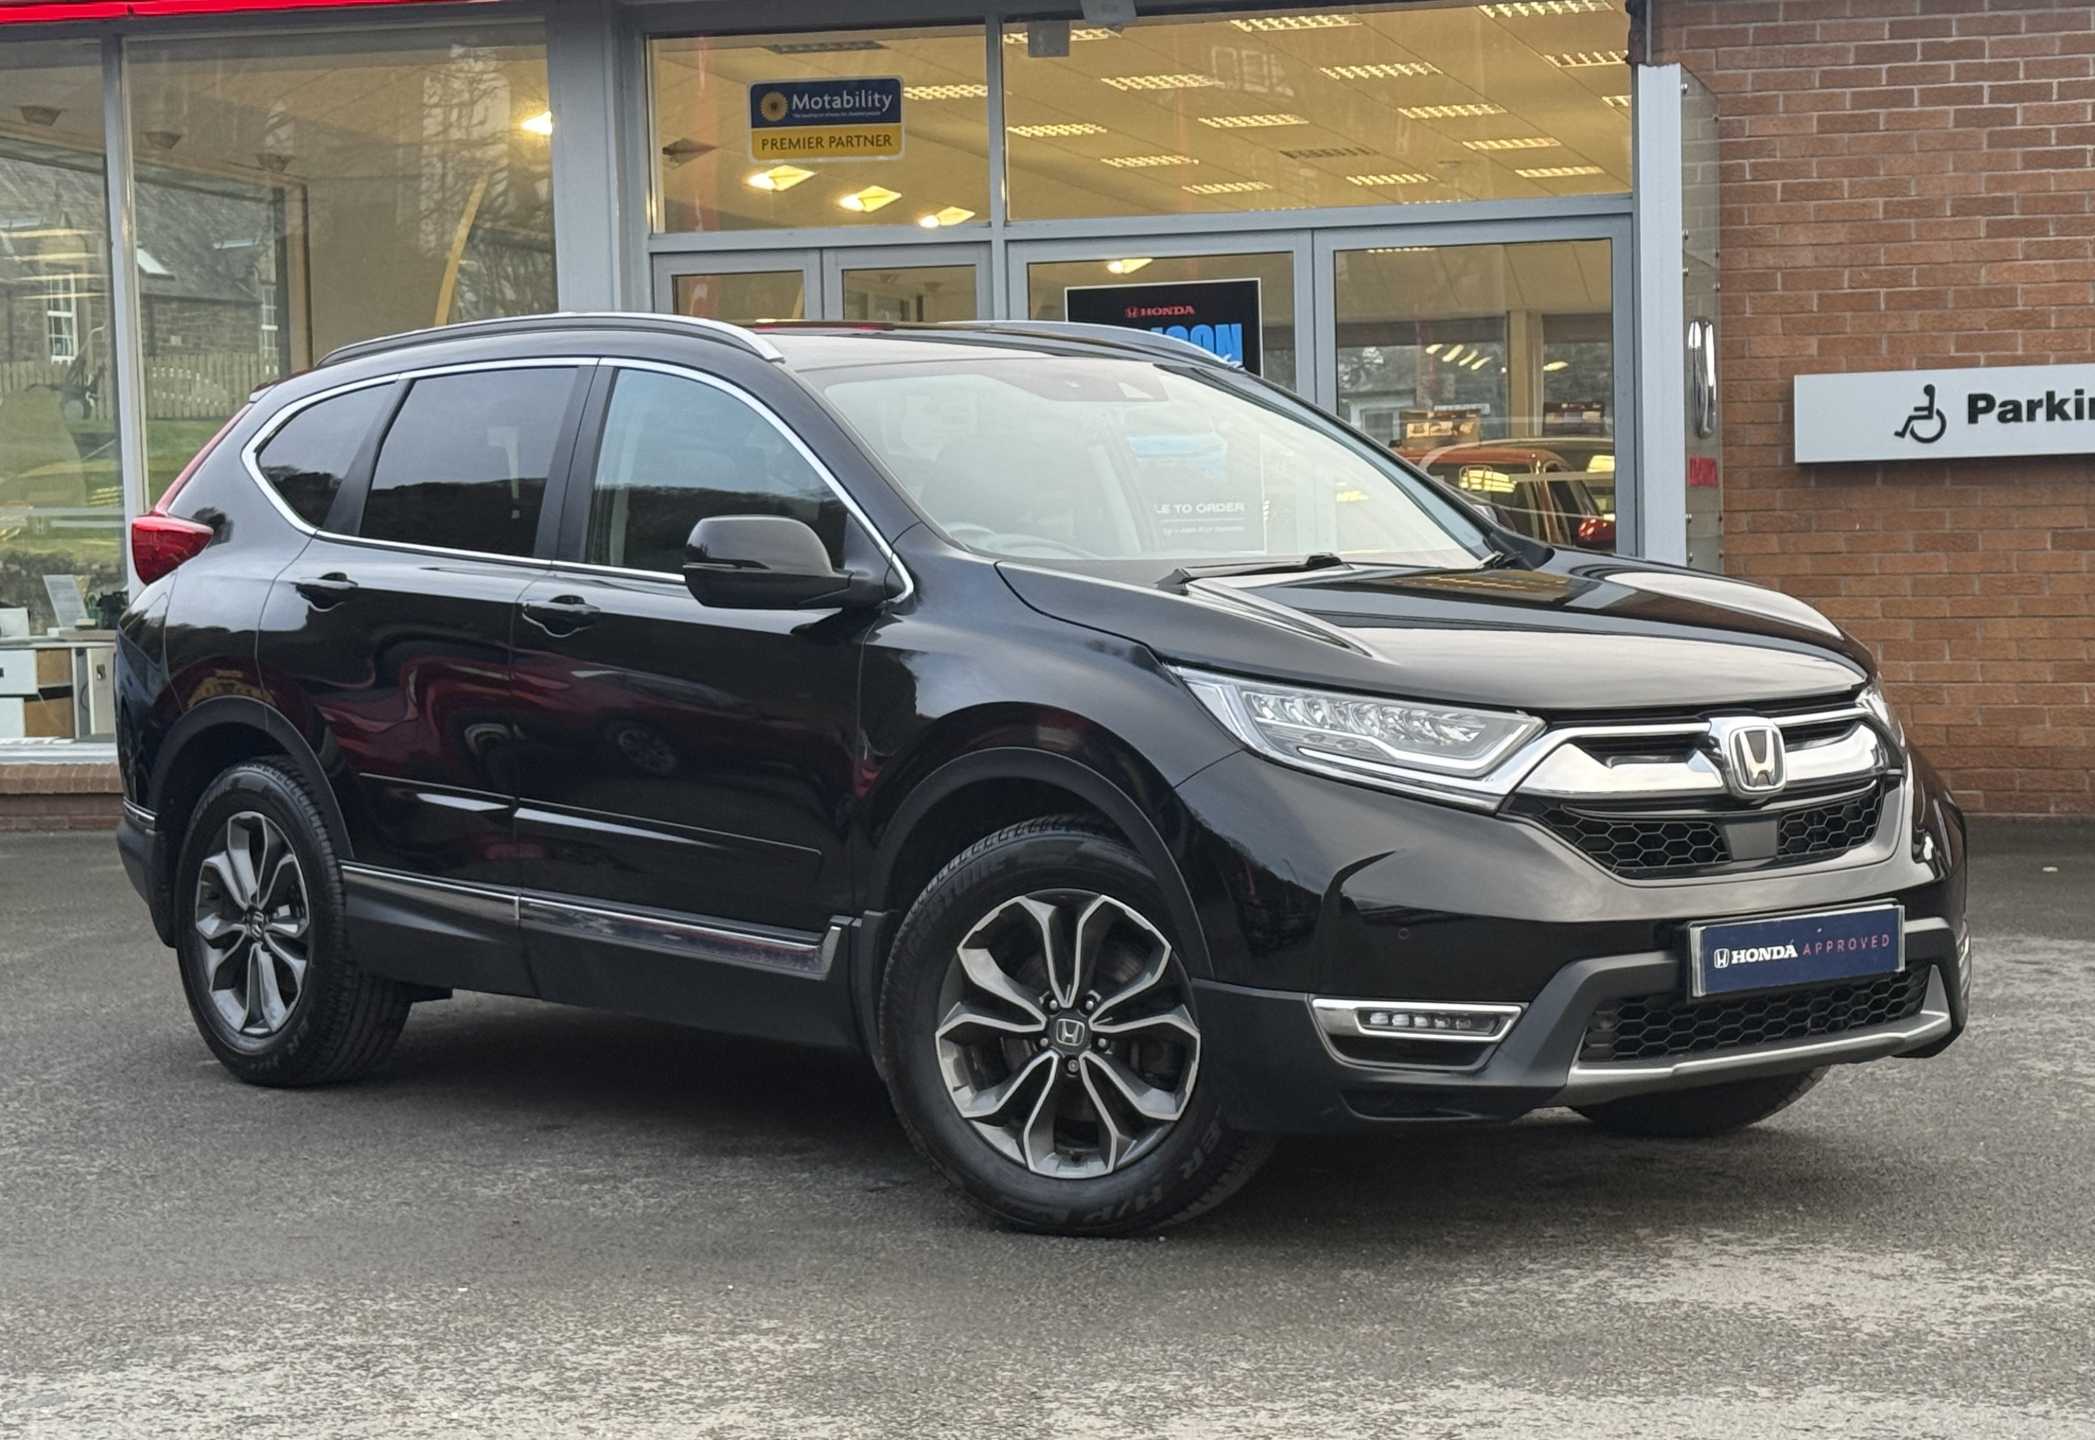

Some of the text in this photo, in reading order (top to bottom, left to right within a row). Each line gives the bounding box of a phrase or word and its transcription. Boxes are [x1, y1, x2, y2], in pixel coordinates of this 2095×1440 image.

[791, 89, 893, 113] Motability
[761, 133, 893, 151] PREMIER PARTNER
[1140, 305, 1195, 317] HONDA
[1174, 503, 1193, 514] TO
[1195, 502, 1245, 514] ORDER
[1731, 933, 1890, 964] HONDA APPROVED
